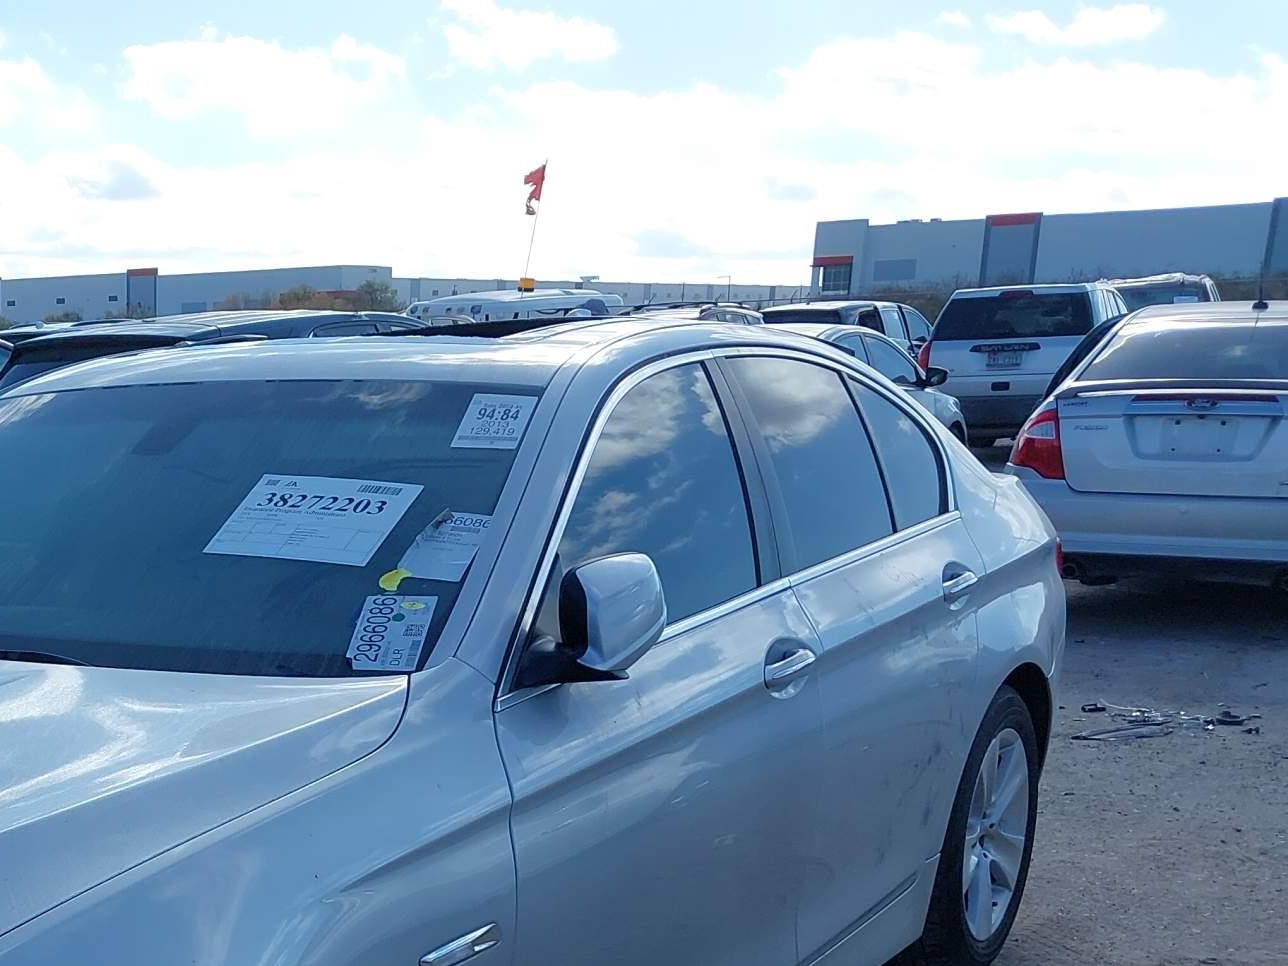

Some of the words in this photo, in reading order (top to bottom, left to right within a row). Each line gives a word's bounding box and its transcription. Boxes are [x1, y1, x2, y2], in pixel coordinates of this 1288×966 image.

[256, 492, 388, 515] 38272203
[353, 597, 398, 662] 2966086
[389, 648, 405, 666] DLR
